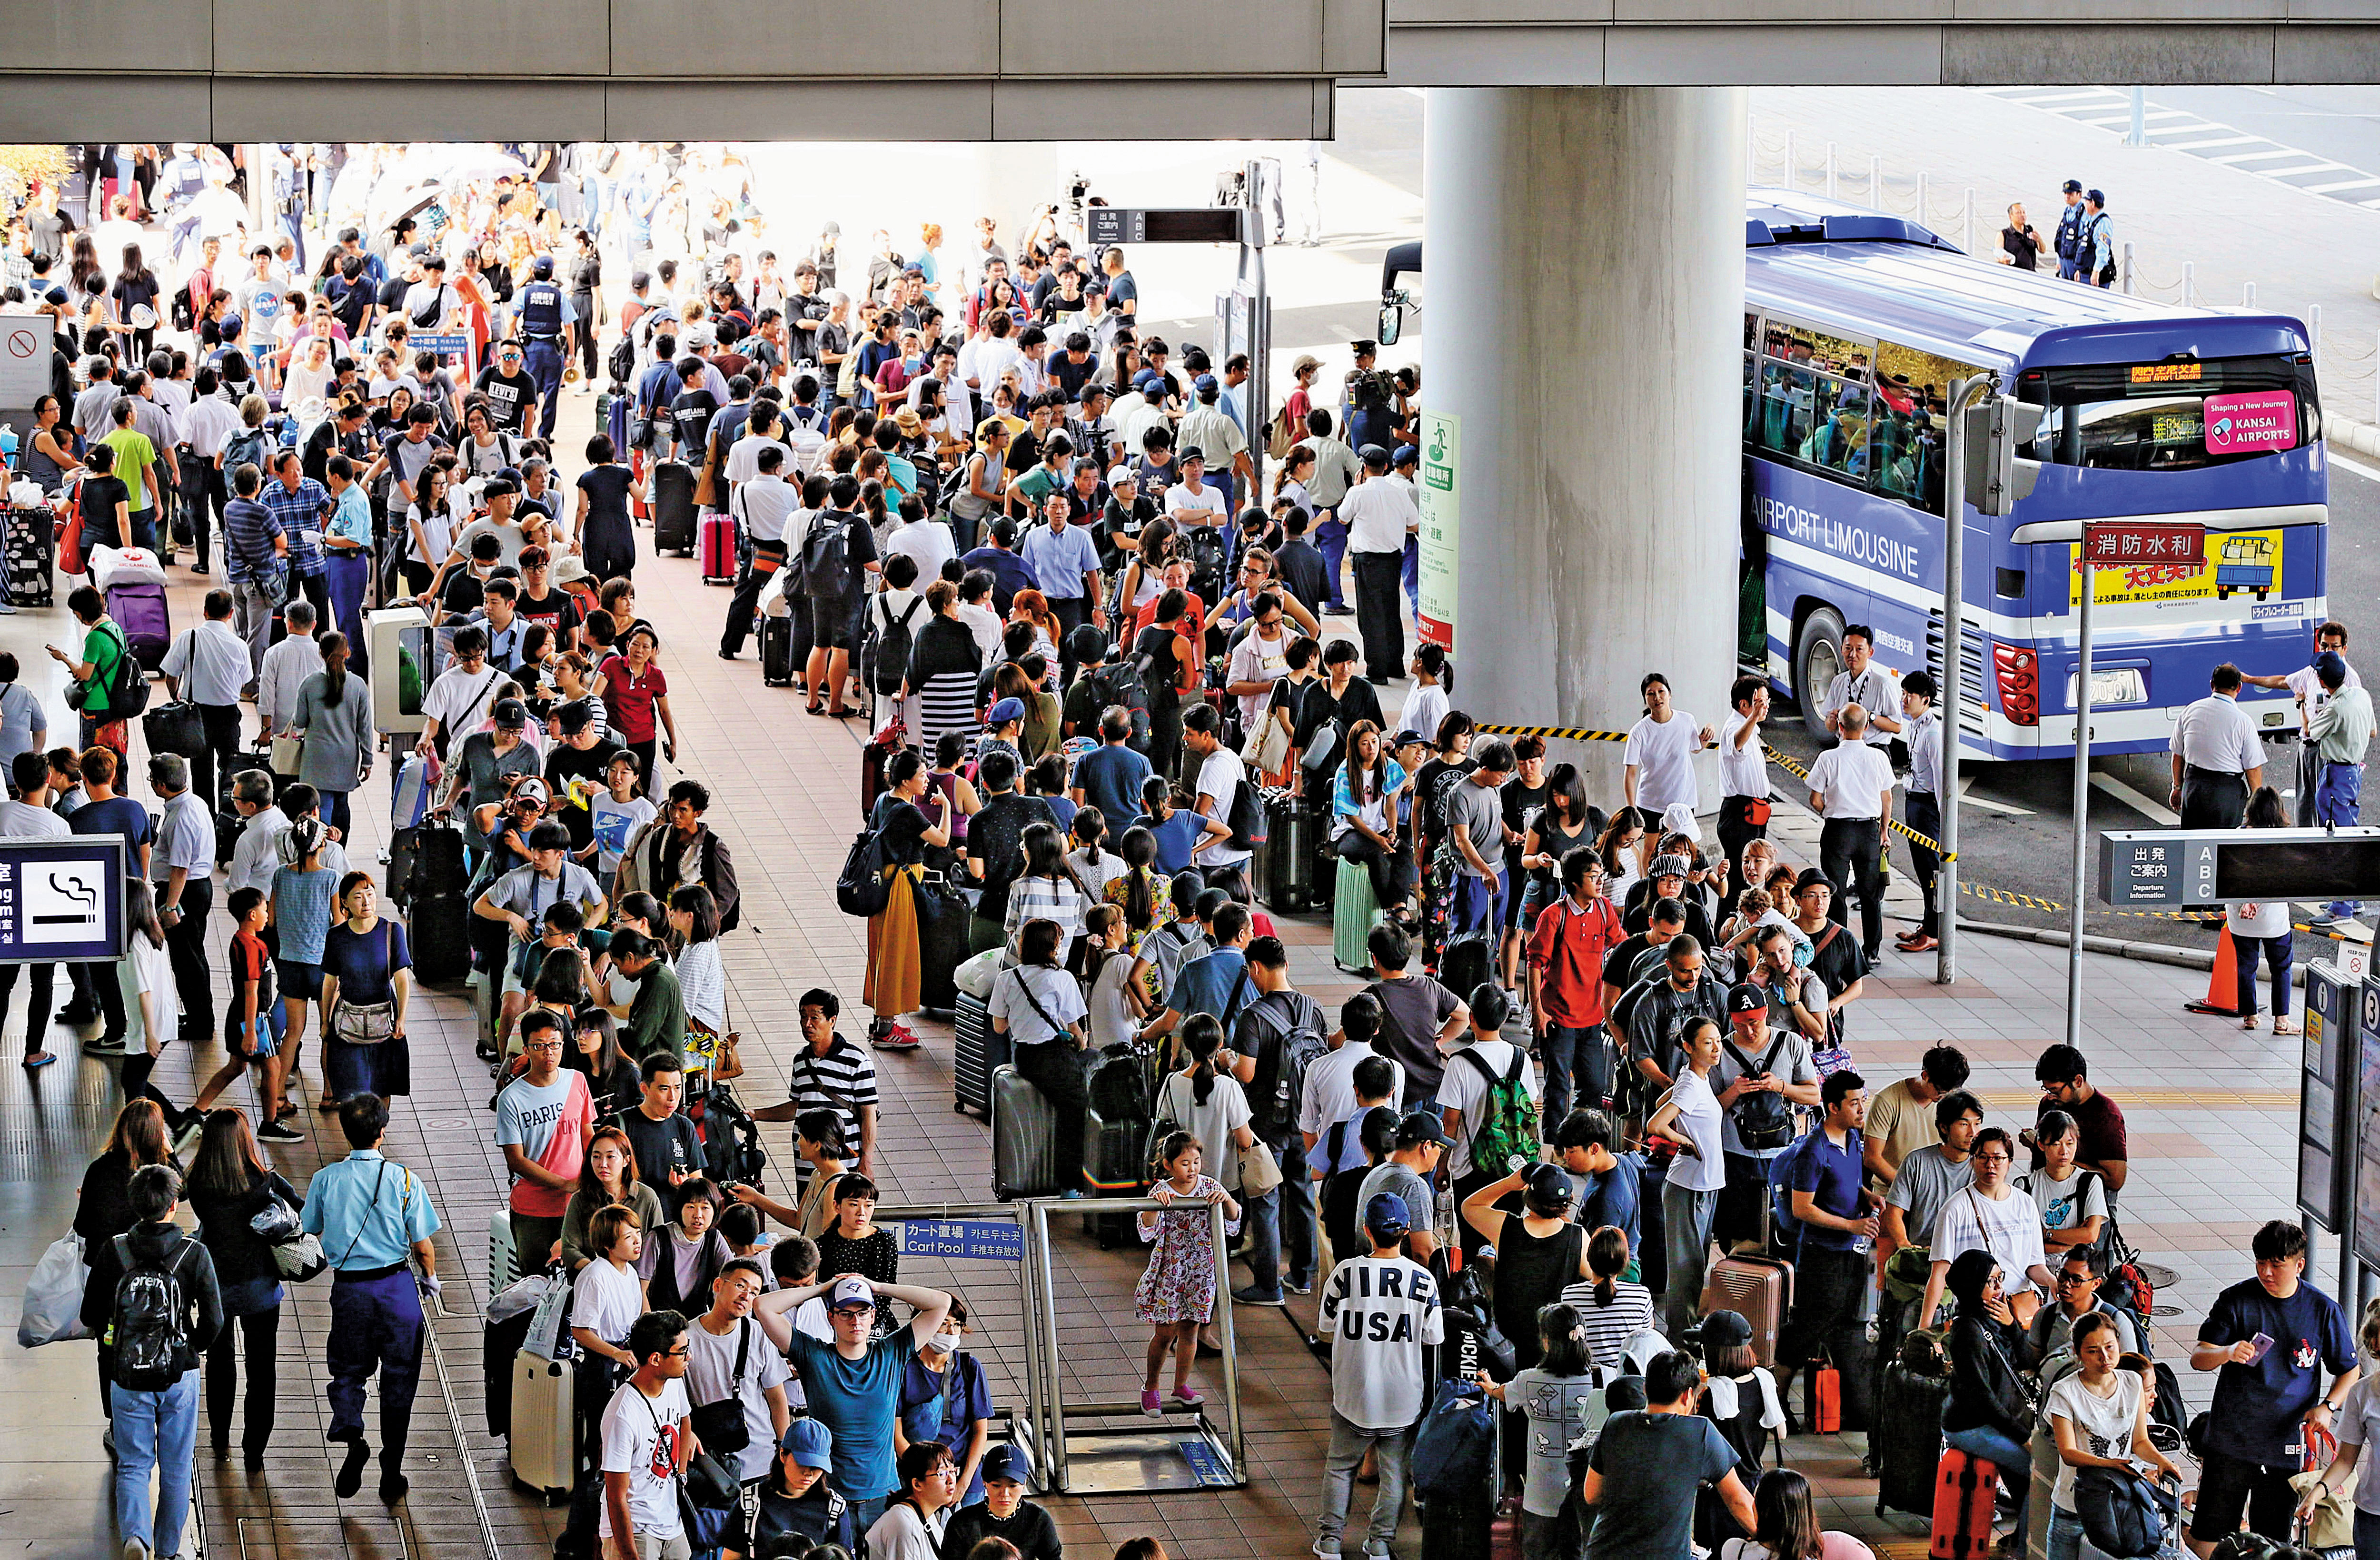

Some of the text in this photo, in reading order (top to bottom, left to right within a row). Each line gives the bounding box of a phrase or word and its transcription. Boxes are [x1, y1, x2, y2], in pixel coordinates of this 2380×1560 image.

[1099, 212, 1117, 220] 出発
[1135, 212, 1142, 220] A
[1097, 221, 1118, 229] ご案内
[1135, 222, 1142, 230] B
[1135, 232, 1142, 240] C
[2132, 374, 2151, 383] Kansai
[2153, 373, 2173, 381] Airport
[491, 385, 515, 398] LEVI'S
[2211, 404, 2238, 412] Shaping
[2236, 417, 2276, 429] KANSAI
[2236, 429, 2291, 443] AIRPORTS
[1751, 494, 1919, 579] AIRPORT LIMOUSINE
[2096, 533, 2192, 556] 消防水利
[2252, 604, 2303, 618] ドライブレコーダー搭載車
[1875, 628, 1914, 656] 関西空港交通
[508, 707, 518, 719] T
[2134, 847, 2165, 861] 出発
[2200, 847, 2212, 860] A
[2130, 864, 2168, 877] ご案内
[2199, 865, 2211, 879] B
[2198, 884, 2211, 898] C
[1741, 994, 1755, 1010] A
[2369, 996, 2376, 1023] 3
[521, 1103, 563, 1128] PARIS
[556, 1117, 581, 1136] TOKY
[907, 1224, 964, 1239] カート置場
[970, 1228, 1020, 1242] 카트두는곳
[907, 1241, 964, 1254] Cart Pool
[970, 1244, 1020, 1257] 手推车存放处
[1342, 1311, 1413, 1342] USA
